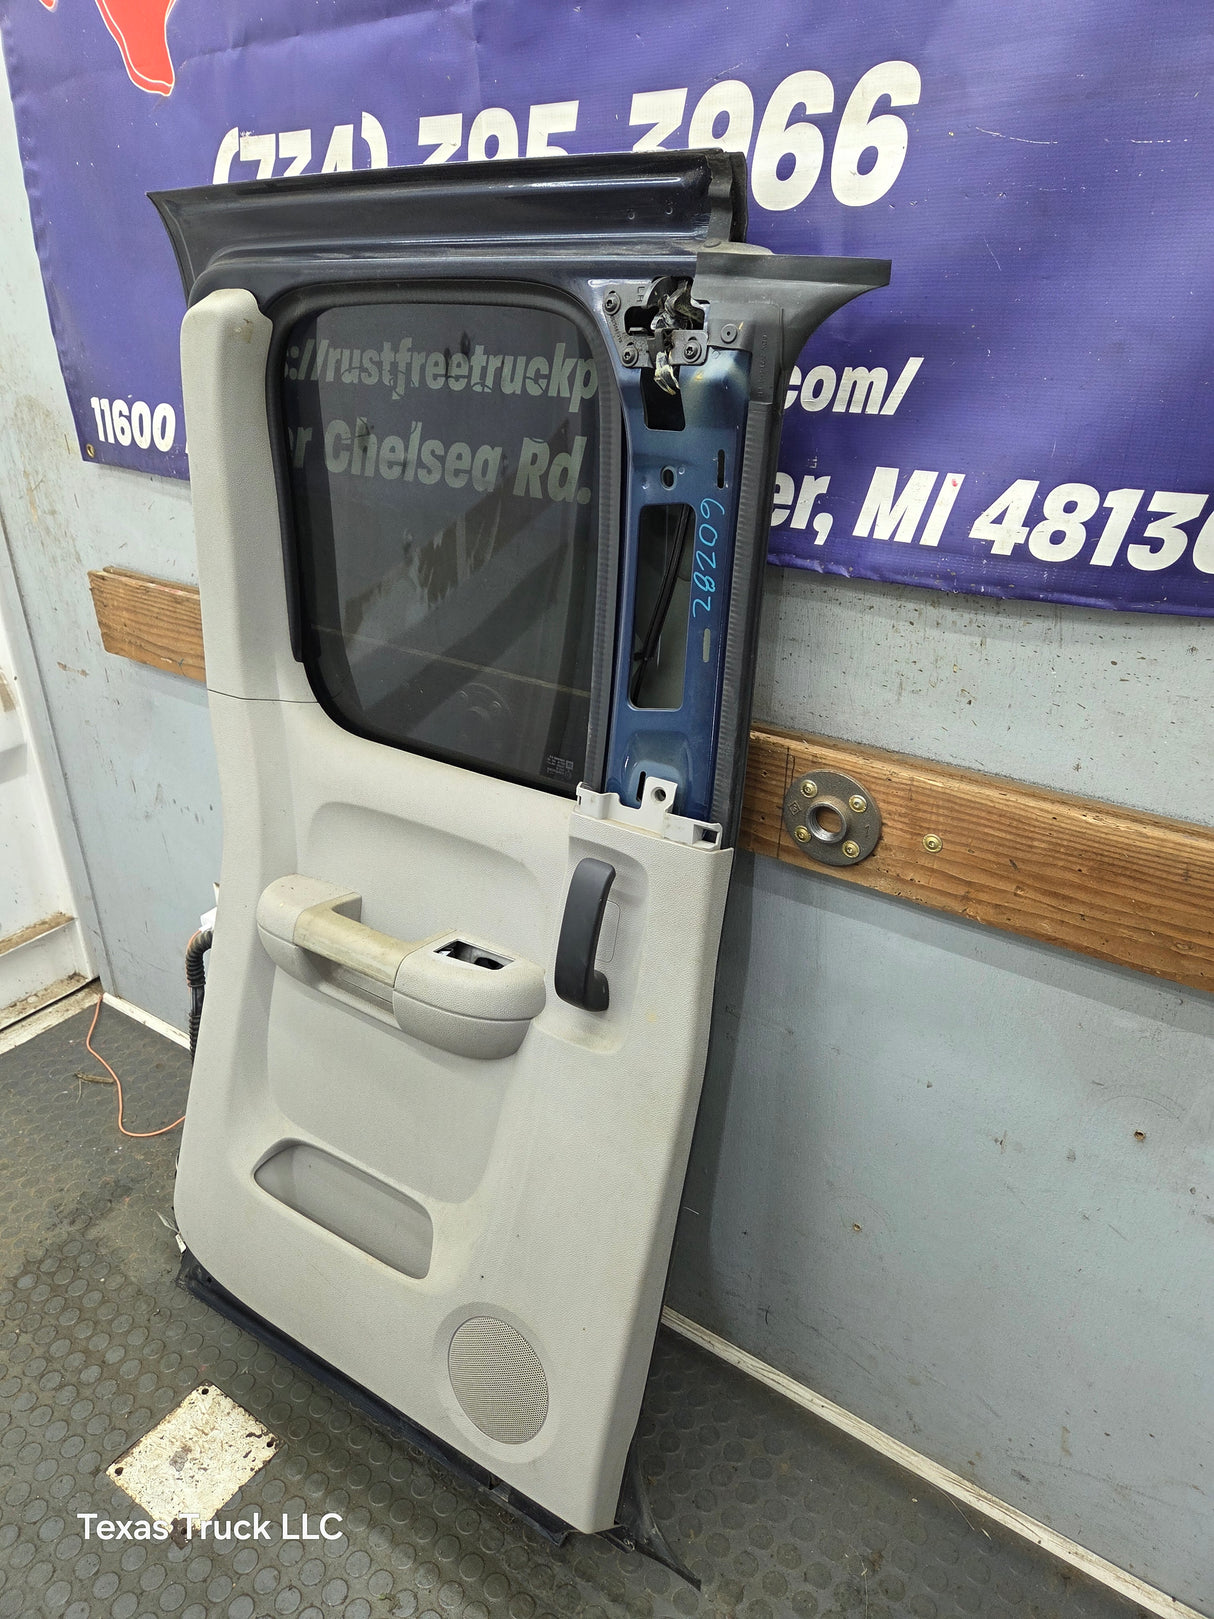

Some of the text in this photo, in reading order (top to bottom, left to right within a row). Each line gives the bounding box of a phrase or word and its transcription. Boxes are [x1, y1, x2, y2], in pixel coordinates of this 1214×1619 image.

[284, 337, 599, 413] ://rustfreetruckp
[90, 396, 176, 452] 11600
[324, 416, 503, 492] Chelsea
[512, 435, 592, 505] Rd.
[852, 466, 966, 547] MI
